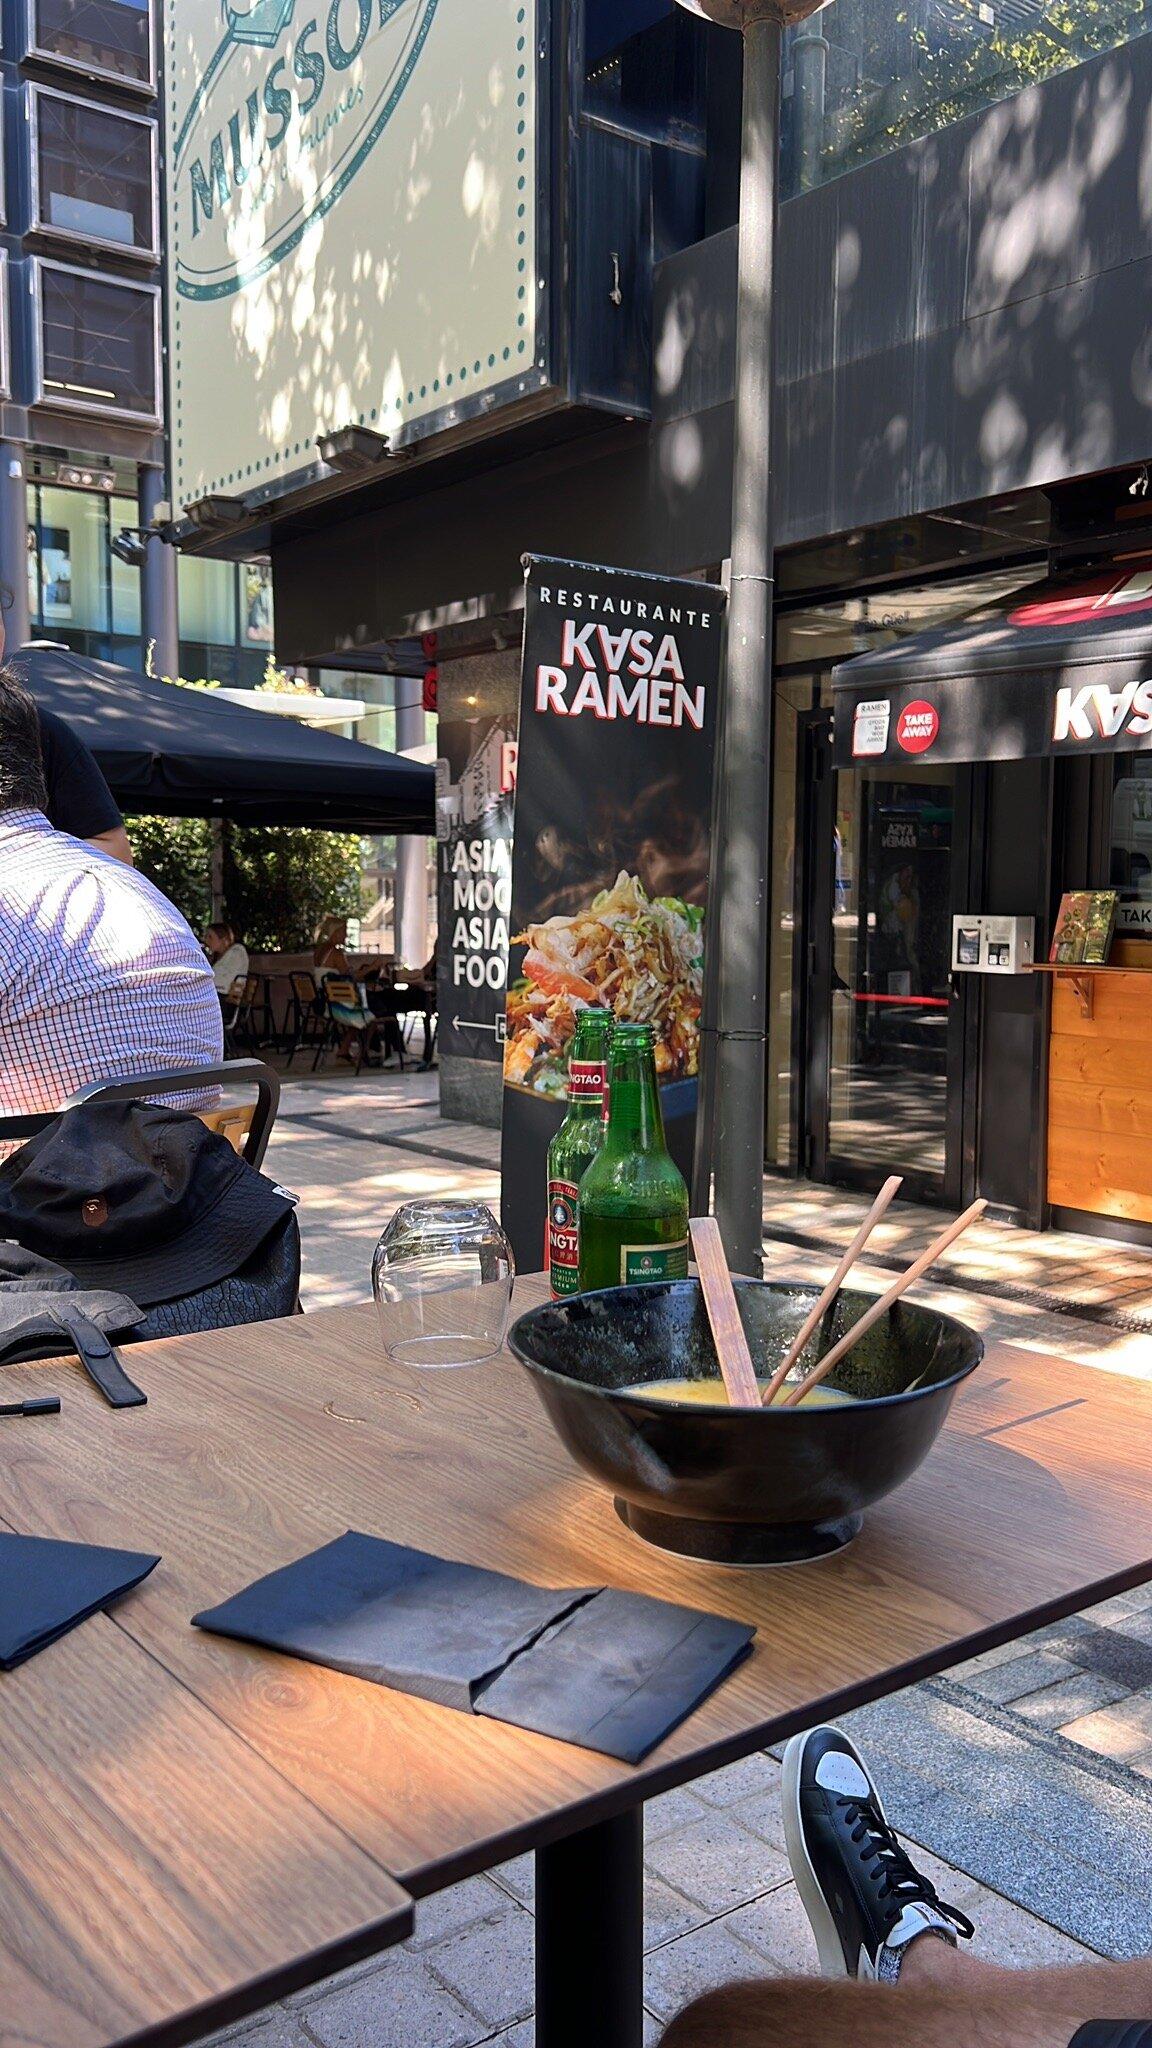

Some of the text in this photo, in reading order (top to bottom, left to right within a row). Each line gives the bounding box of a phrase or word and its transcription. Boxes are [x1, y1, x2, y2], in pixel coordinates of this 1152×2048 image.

[189, 0, 407, 239] MUSSO
[540, 586, 710, 628] RESTAURANTE
[535, 664, 705, 731] RAMEN
[860, 703, 887, 714] RAMEN
[904, 712, 934, 726] TAKE
[901, 725, 934, 739] AWAY
[451, 837, 513, 873] ASIA
[629, 1267, 663, 1276] TSINGTAO
